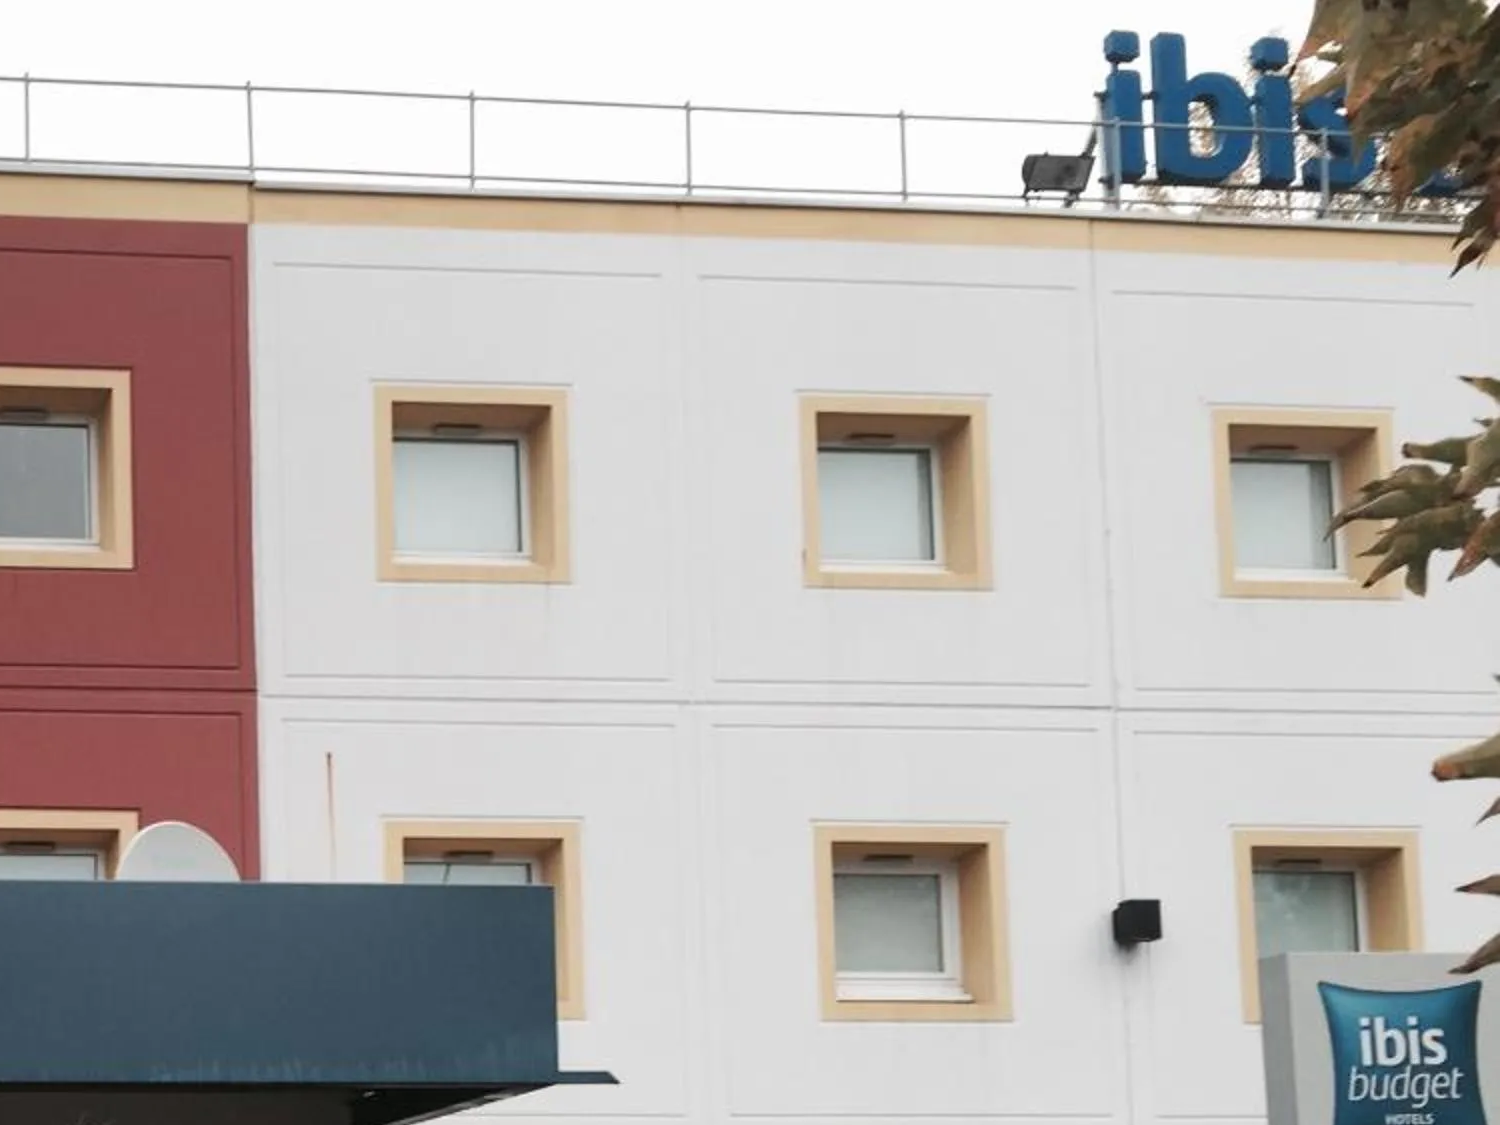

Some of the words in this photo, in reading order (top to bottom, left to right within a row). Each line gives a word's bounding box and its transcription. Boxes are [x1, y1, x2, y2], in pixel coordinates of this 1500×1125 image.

[1359, 1016, 1448, 1066] ibis
[1348, 1065, 1464, 1108] budget
[1385, 1113, 1436, 1125] HOTELS
